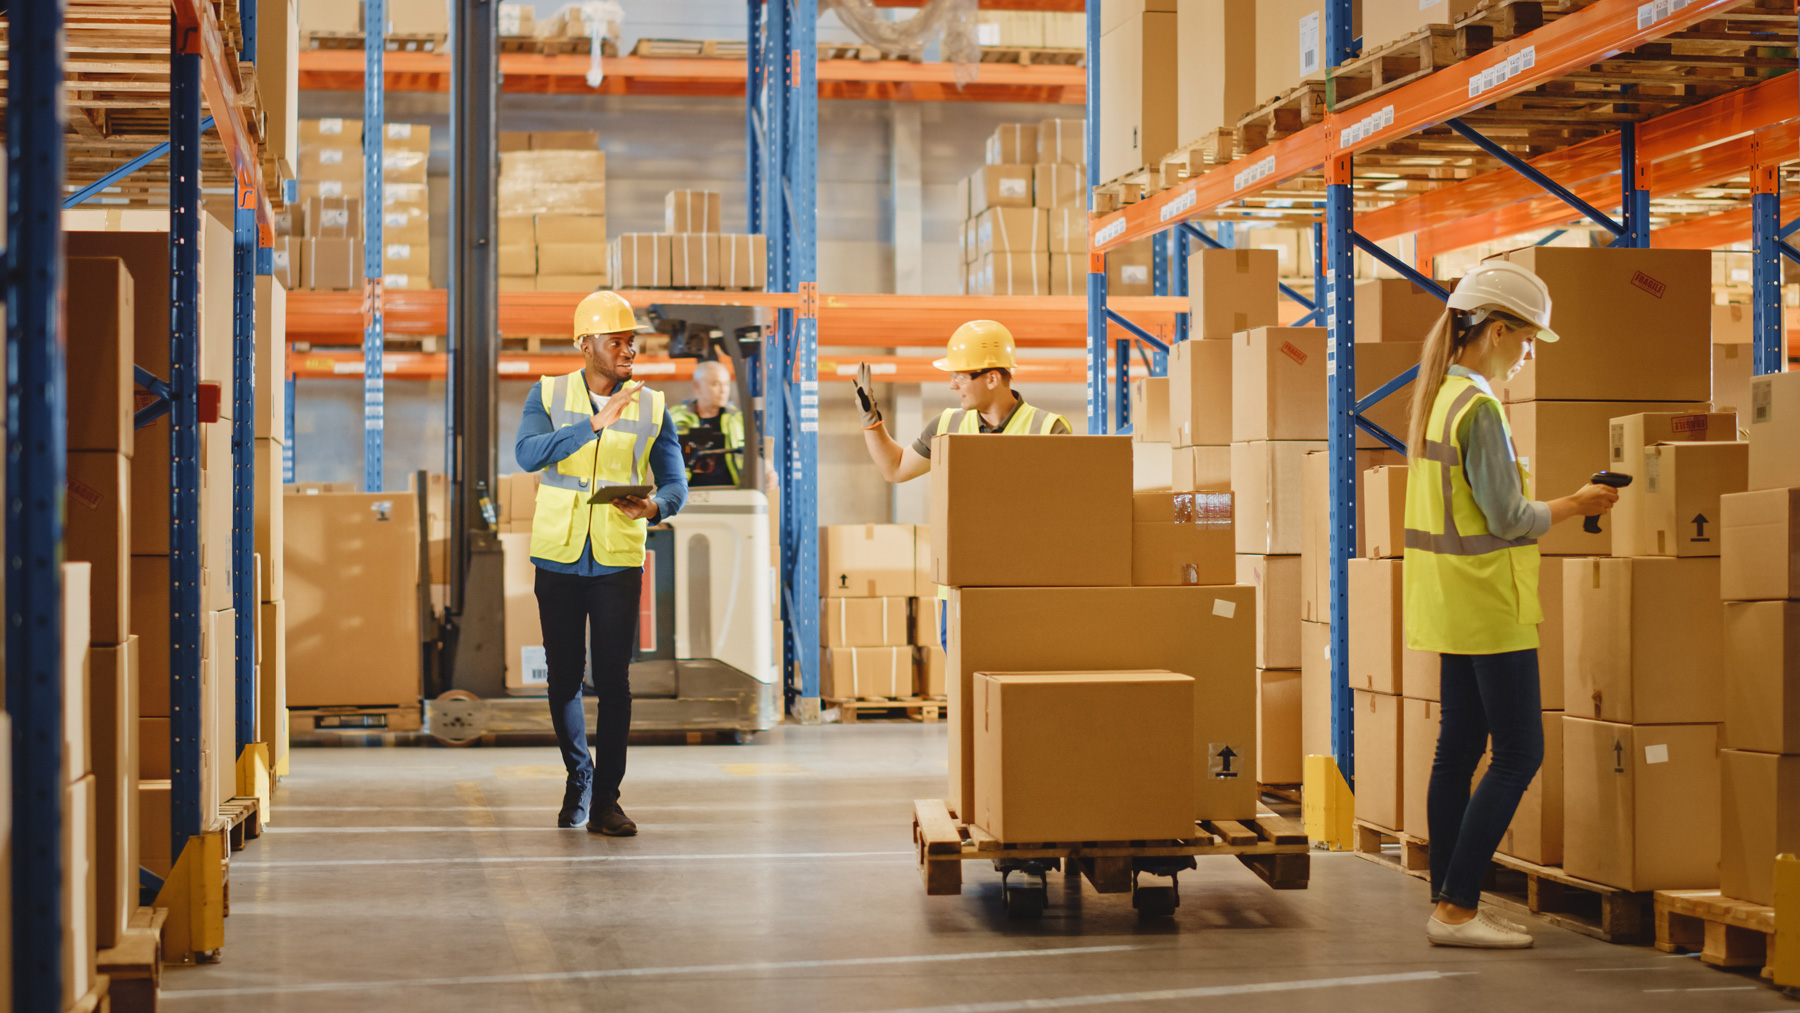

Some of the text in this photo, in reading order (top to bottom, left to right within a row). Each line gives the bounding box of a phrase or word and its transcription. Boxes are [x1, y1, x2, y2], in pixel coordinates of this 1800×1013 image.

[1635, 273, 1663, 294] FRAGILE
[1284, 344, 1305, 361] FRAGILE
[1674, 419, 1705, 430] FRAGILE
